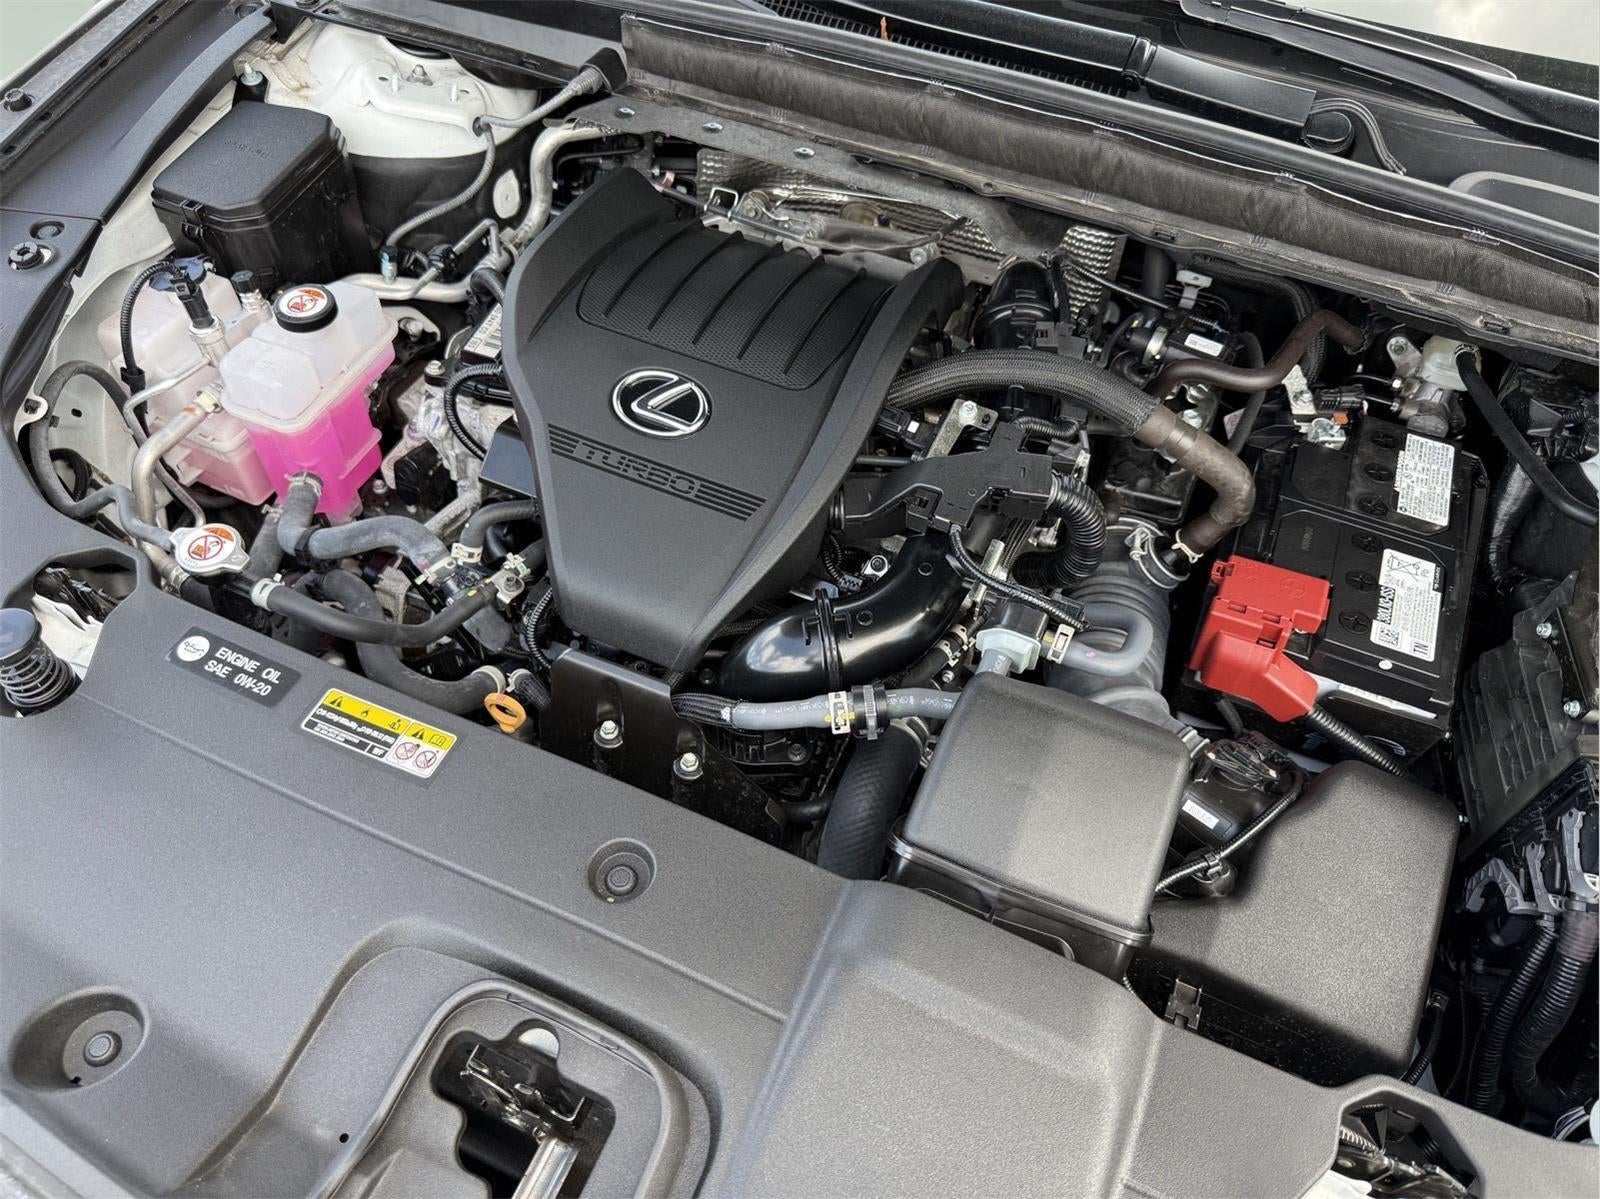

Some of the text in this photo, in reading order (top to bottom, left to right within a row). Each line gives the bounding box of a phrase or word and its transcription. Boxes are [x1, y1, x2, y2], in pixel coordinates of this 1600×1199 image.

[578, 442, 697, 496] TURBO
[215, 647, 283, 684] ENGINE OIL
[1413, 642, 1429, 656] TN
[204, 659, 272, 697] SAE 0W-20
